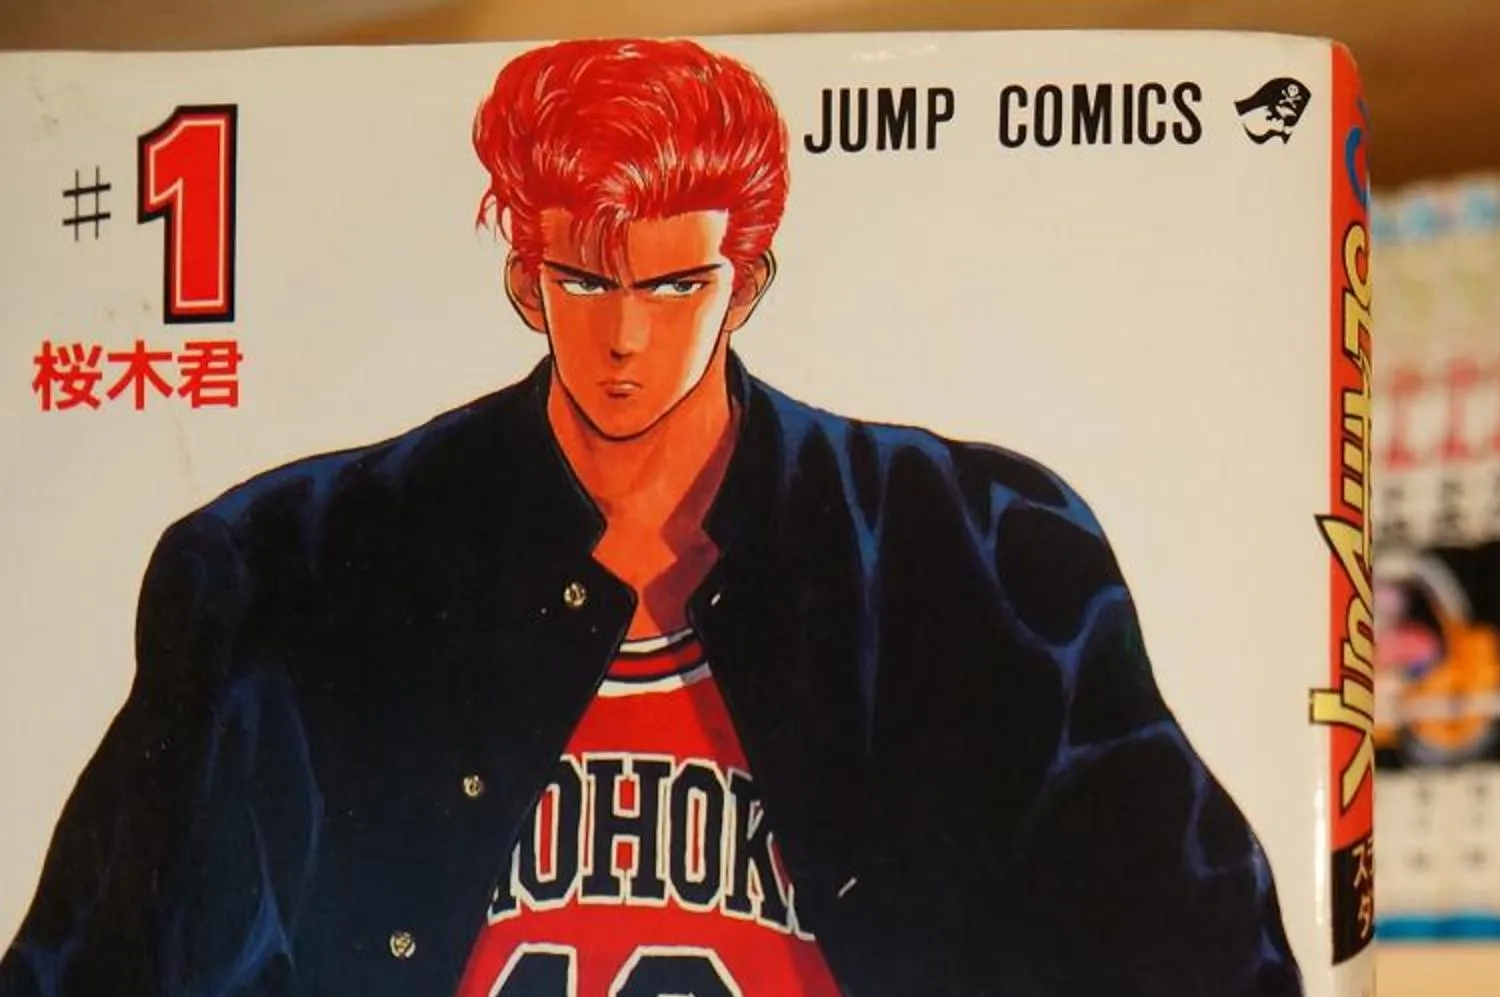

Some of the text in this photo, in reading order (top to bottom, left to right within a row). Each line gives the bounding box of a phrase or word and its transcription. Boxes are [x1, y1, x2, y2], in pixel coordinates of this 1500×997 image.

[804, 81, 1203, 154] JUMP COMICS
[32, 340, 243, 412] 桜木君
